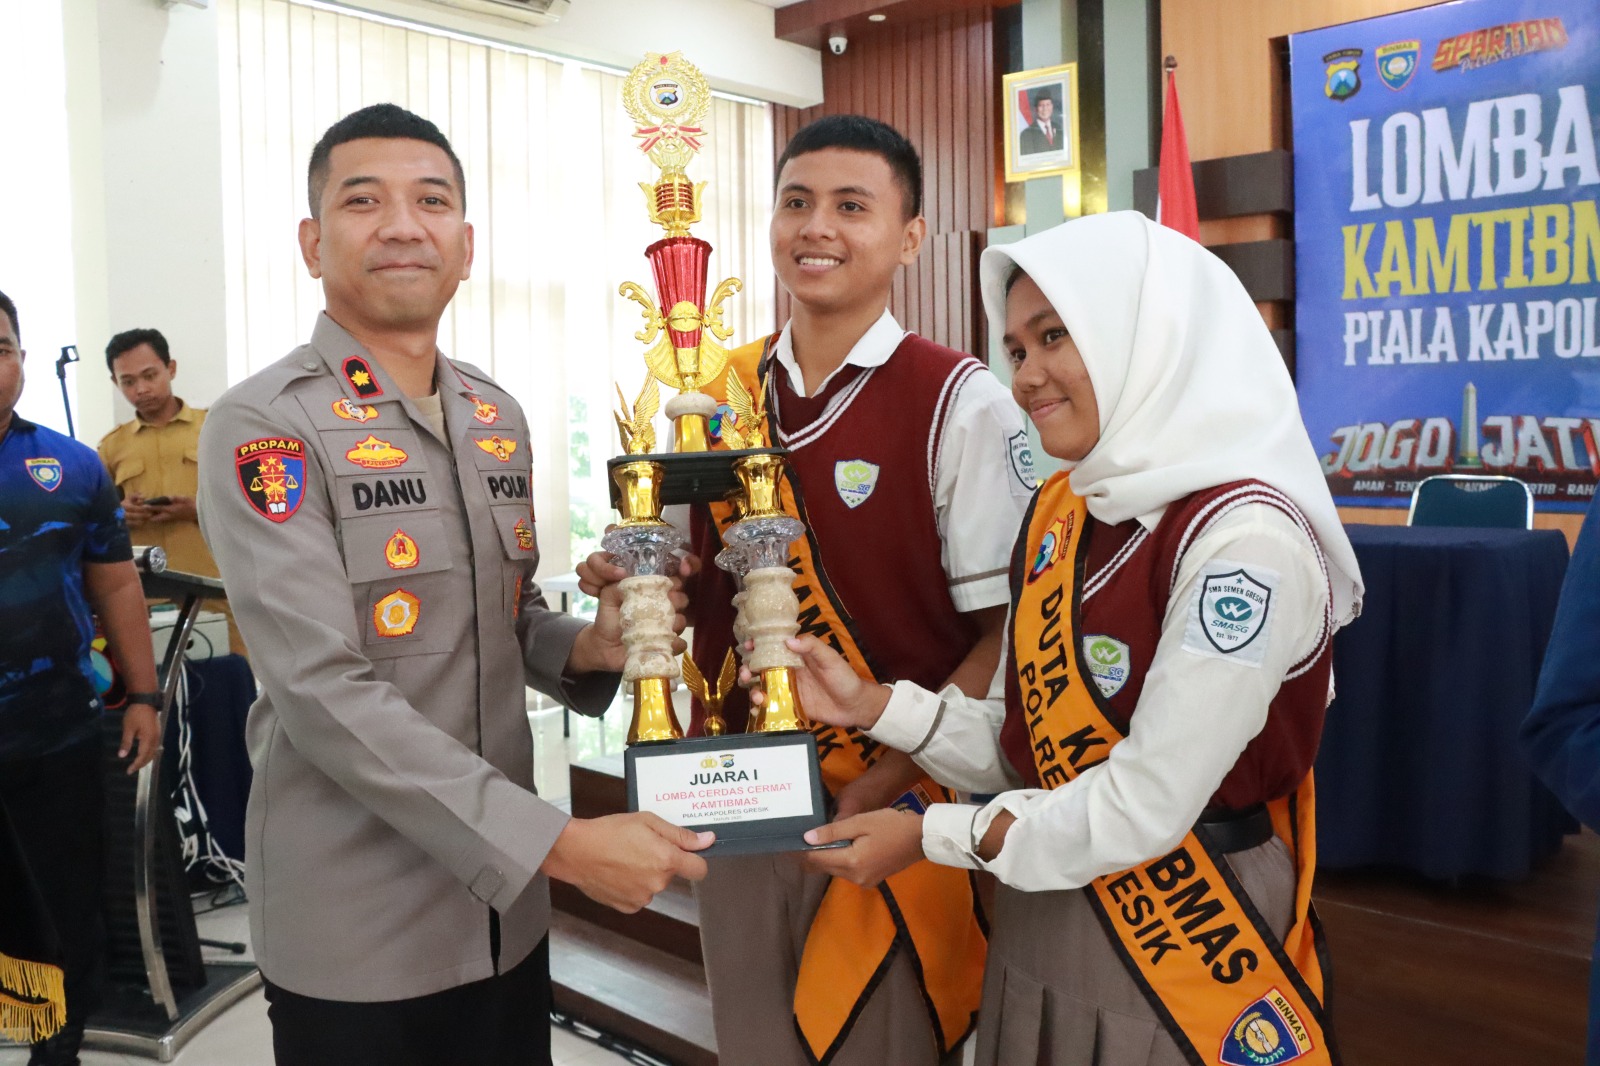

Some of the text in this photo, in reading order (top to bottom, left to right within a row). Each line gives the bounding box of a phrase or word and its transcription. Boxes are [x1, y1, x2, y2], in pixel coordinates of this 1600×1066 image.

[1431, 17, 1568, 71] SPARTAN
[1349, 84, 1600, 212] LOMBA
[1343, 307, 1458, 367] PIALA
[240, 440, 299, 456] PROPAM
[1320, 419, 1453, 474] JOGO
[351, 477, 427, 511] DANU
[487, 475, 529, 500] POLRI
[1353, 480, 1386, 492] AMAN
[1527, 483, 1556, 494] RTIB
[1208, 585, 1264, 605] SMA SEMEN GRESIK
[1210, 619, 1250, 634] SMASG
[1038, 583, 1069, 709] DUTA
[689, 768, 758, 786] JUARA I
[655, 782, 793, 802] LOMBA CERDAS CERMAT
[692, 797, 759, 810] KAMTIBMAS
[682, 806, 769, 819] PIALA KAPOLRES GRESIK
[1101, 870, 1182, 967] ESIK
[1274, 996, 1307, 1043] BINMAS
